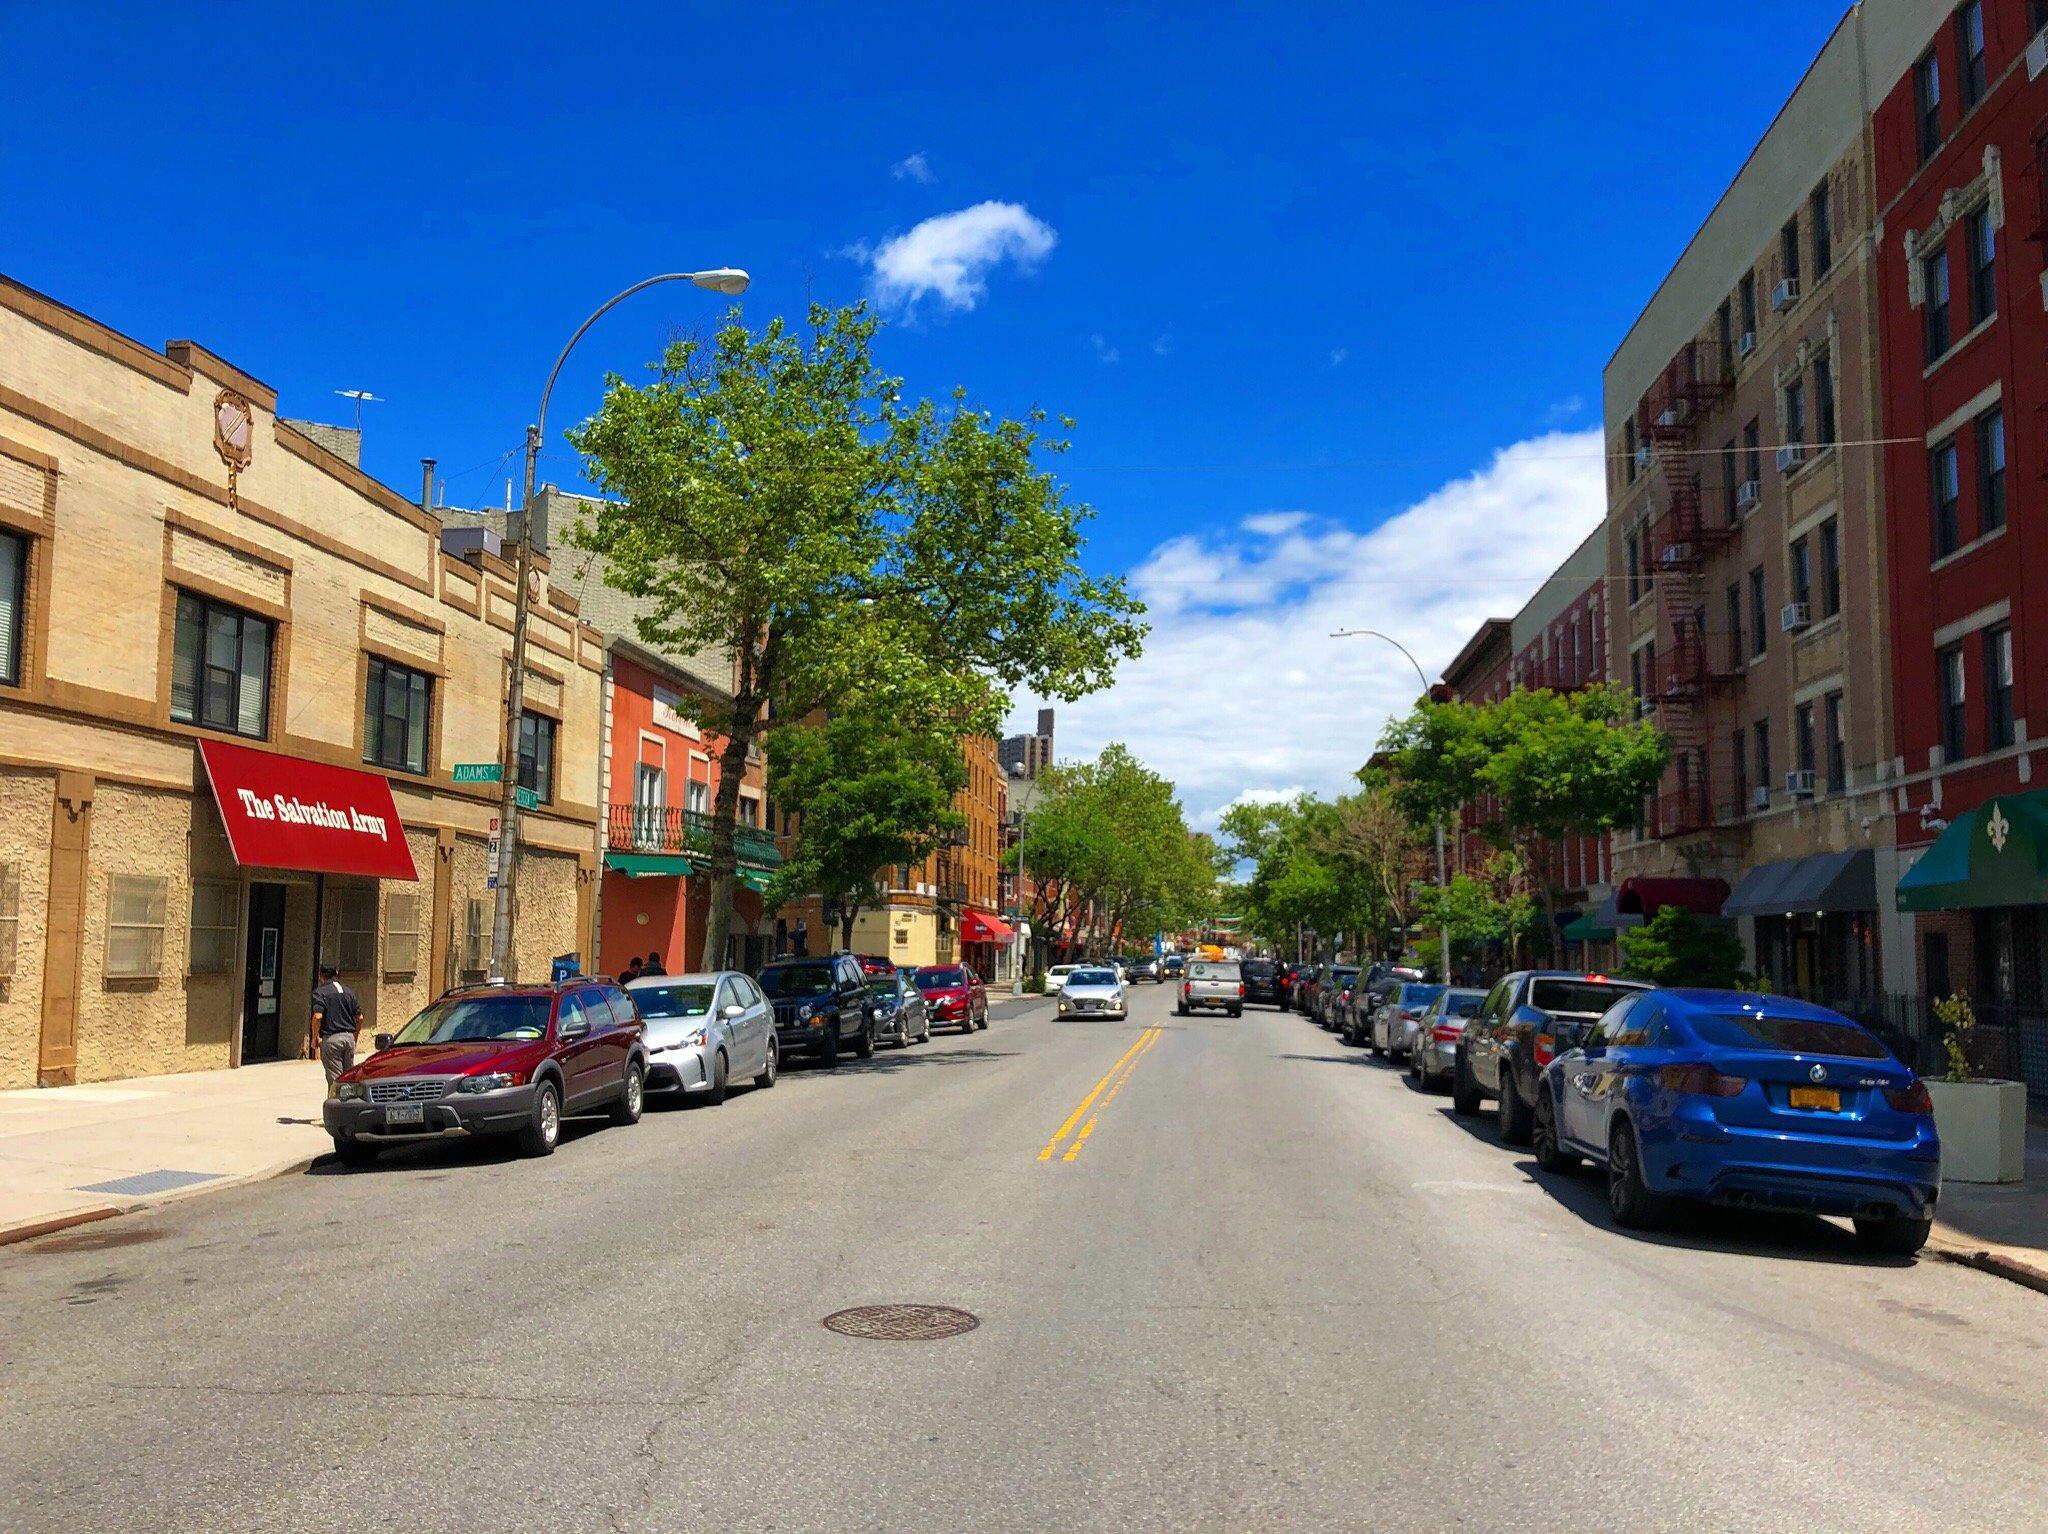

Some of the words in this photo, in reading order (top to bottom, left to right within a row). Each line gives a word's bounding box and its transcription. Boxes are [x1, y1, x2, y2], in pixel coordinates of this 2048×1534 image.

[455, 766, 489, 780] ADAMS
[237, 788, 276, 820] The
[274, 793, 351, 830] Salvation
[350, 806, 388, 842] Army
